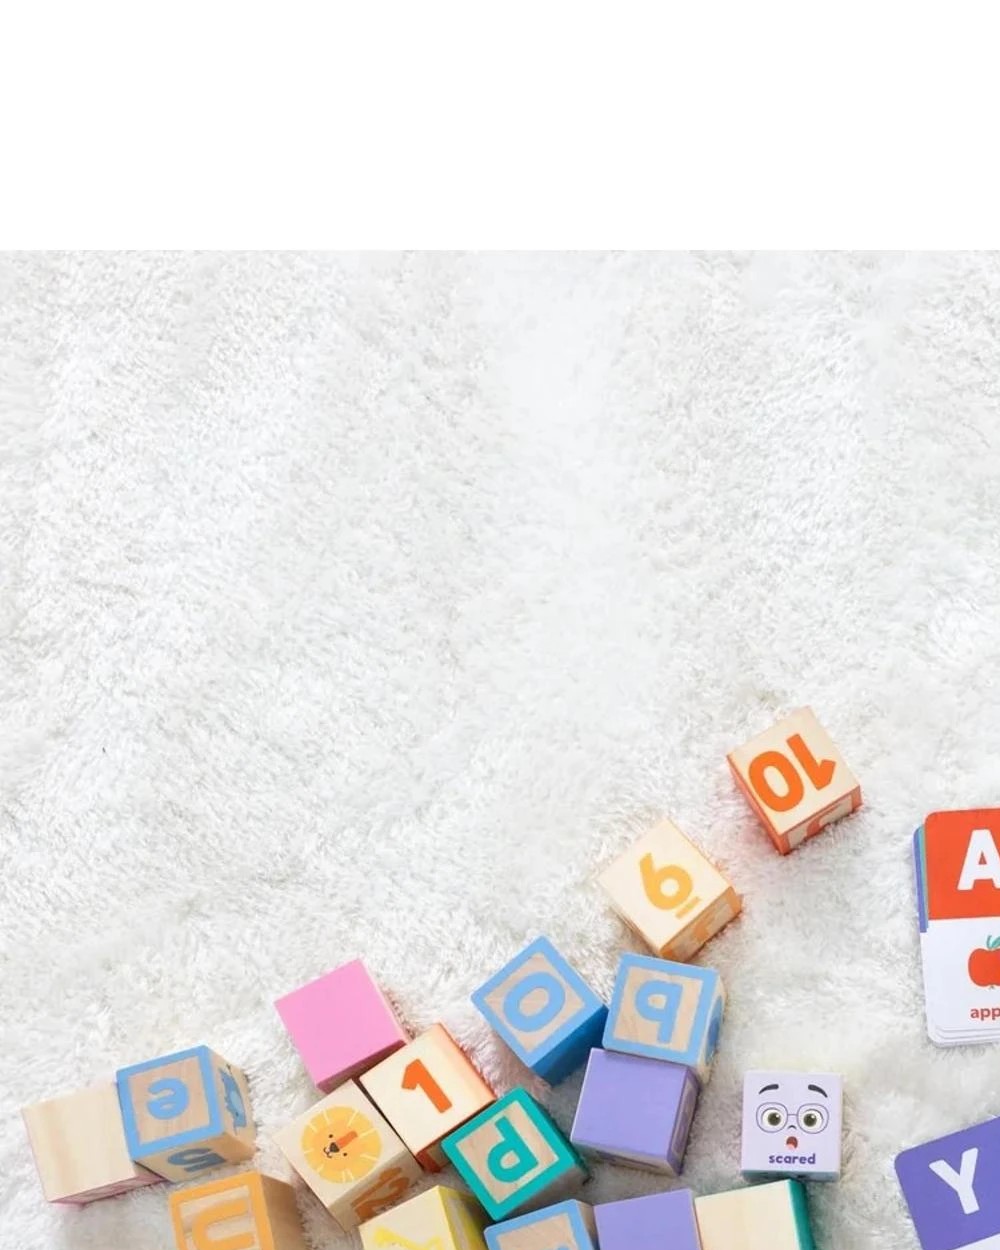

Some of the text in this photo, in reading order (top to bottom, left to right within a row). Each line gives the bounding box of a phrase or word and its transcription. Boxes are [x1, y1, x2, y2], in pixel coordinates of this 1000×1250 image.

[747, 733, 836, 813] 10
[640, 852, 702, 919] 6
[402, 1059, 453, 1113] 1
[768, 1153, 817, 1165] scared
[929, 1147, 980, 1215] Y
